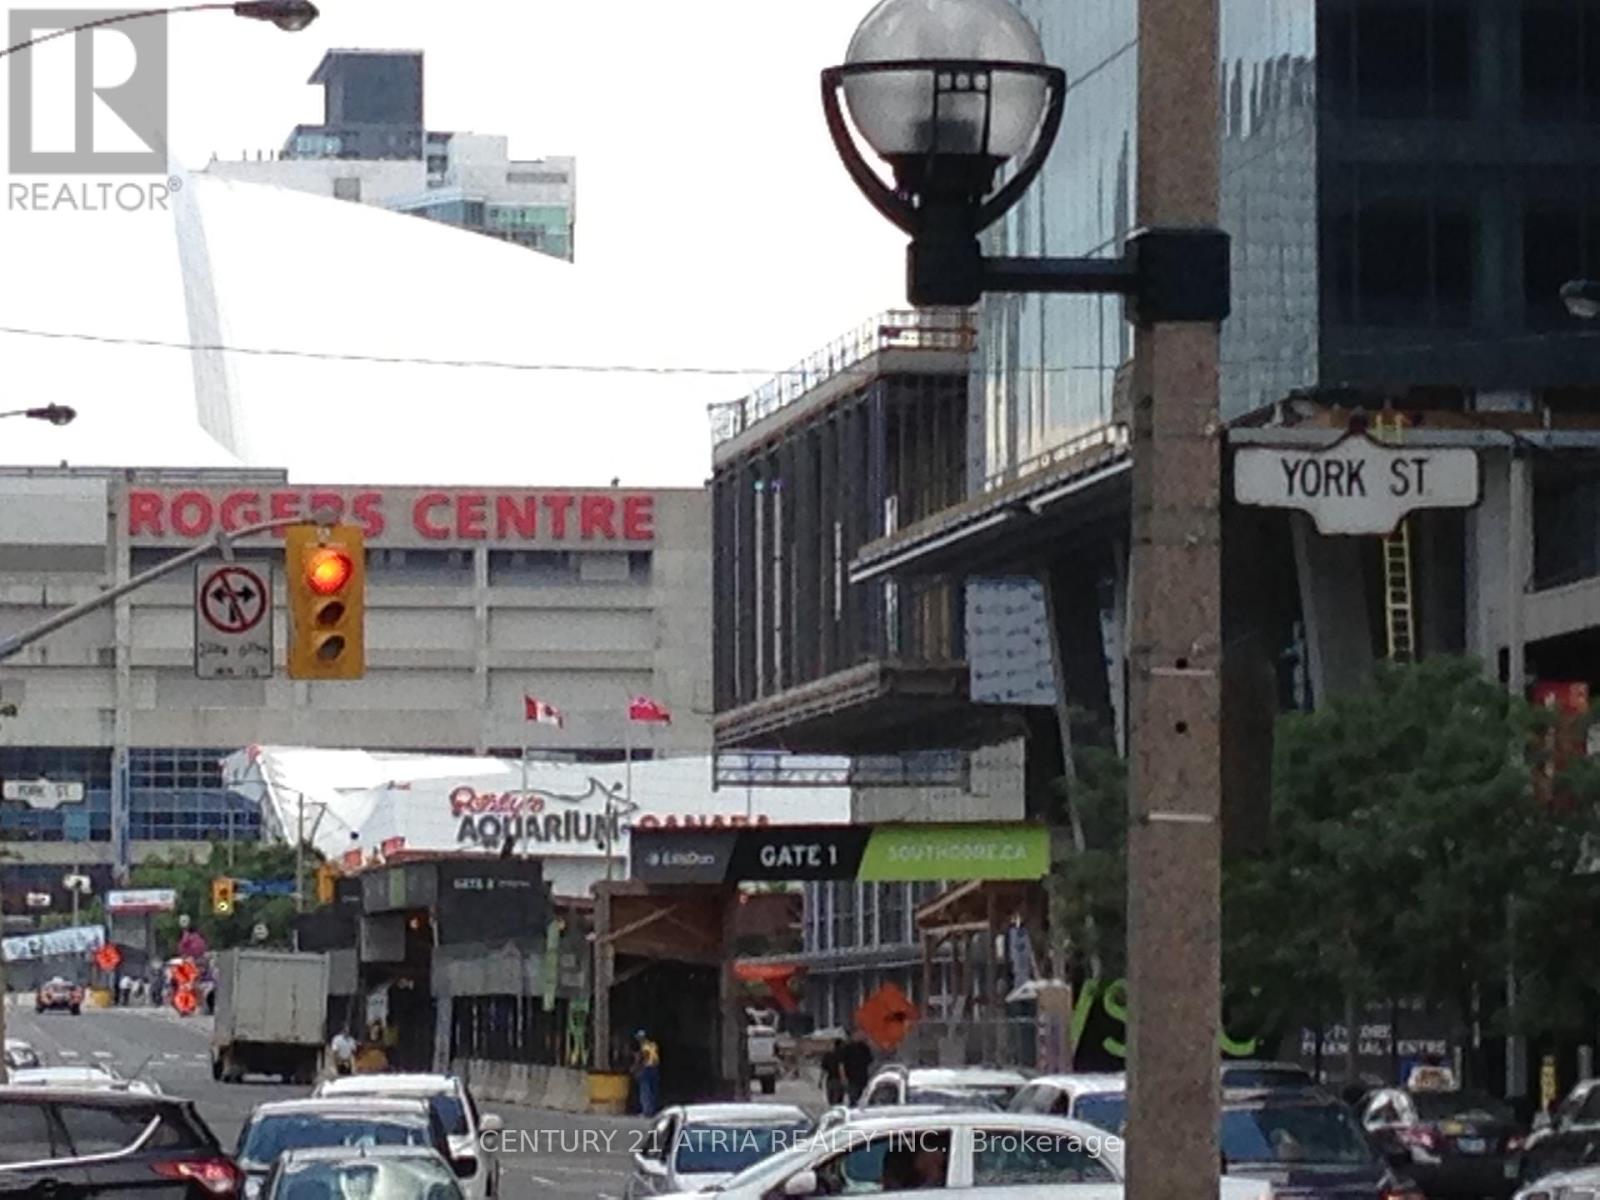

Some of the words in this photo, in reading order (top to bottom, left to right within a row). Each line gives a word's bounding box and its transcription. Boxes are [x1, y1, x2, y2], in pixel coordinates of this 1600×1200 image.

[1281, 458, 1366, 497] YORK
[1390, 458, 1430, 496] ST
[412, 493, 655, 540] CENTRE
[457, 808, 619, 847] AQUARIUM
[760, 845, 822, 867] GATE
[828, 845, 839, 866] 1
